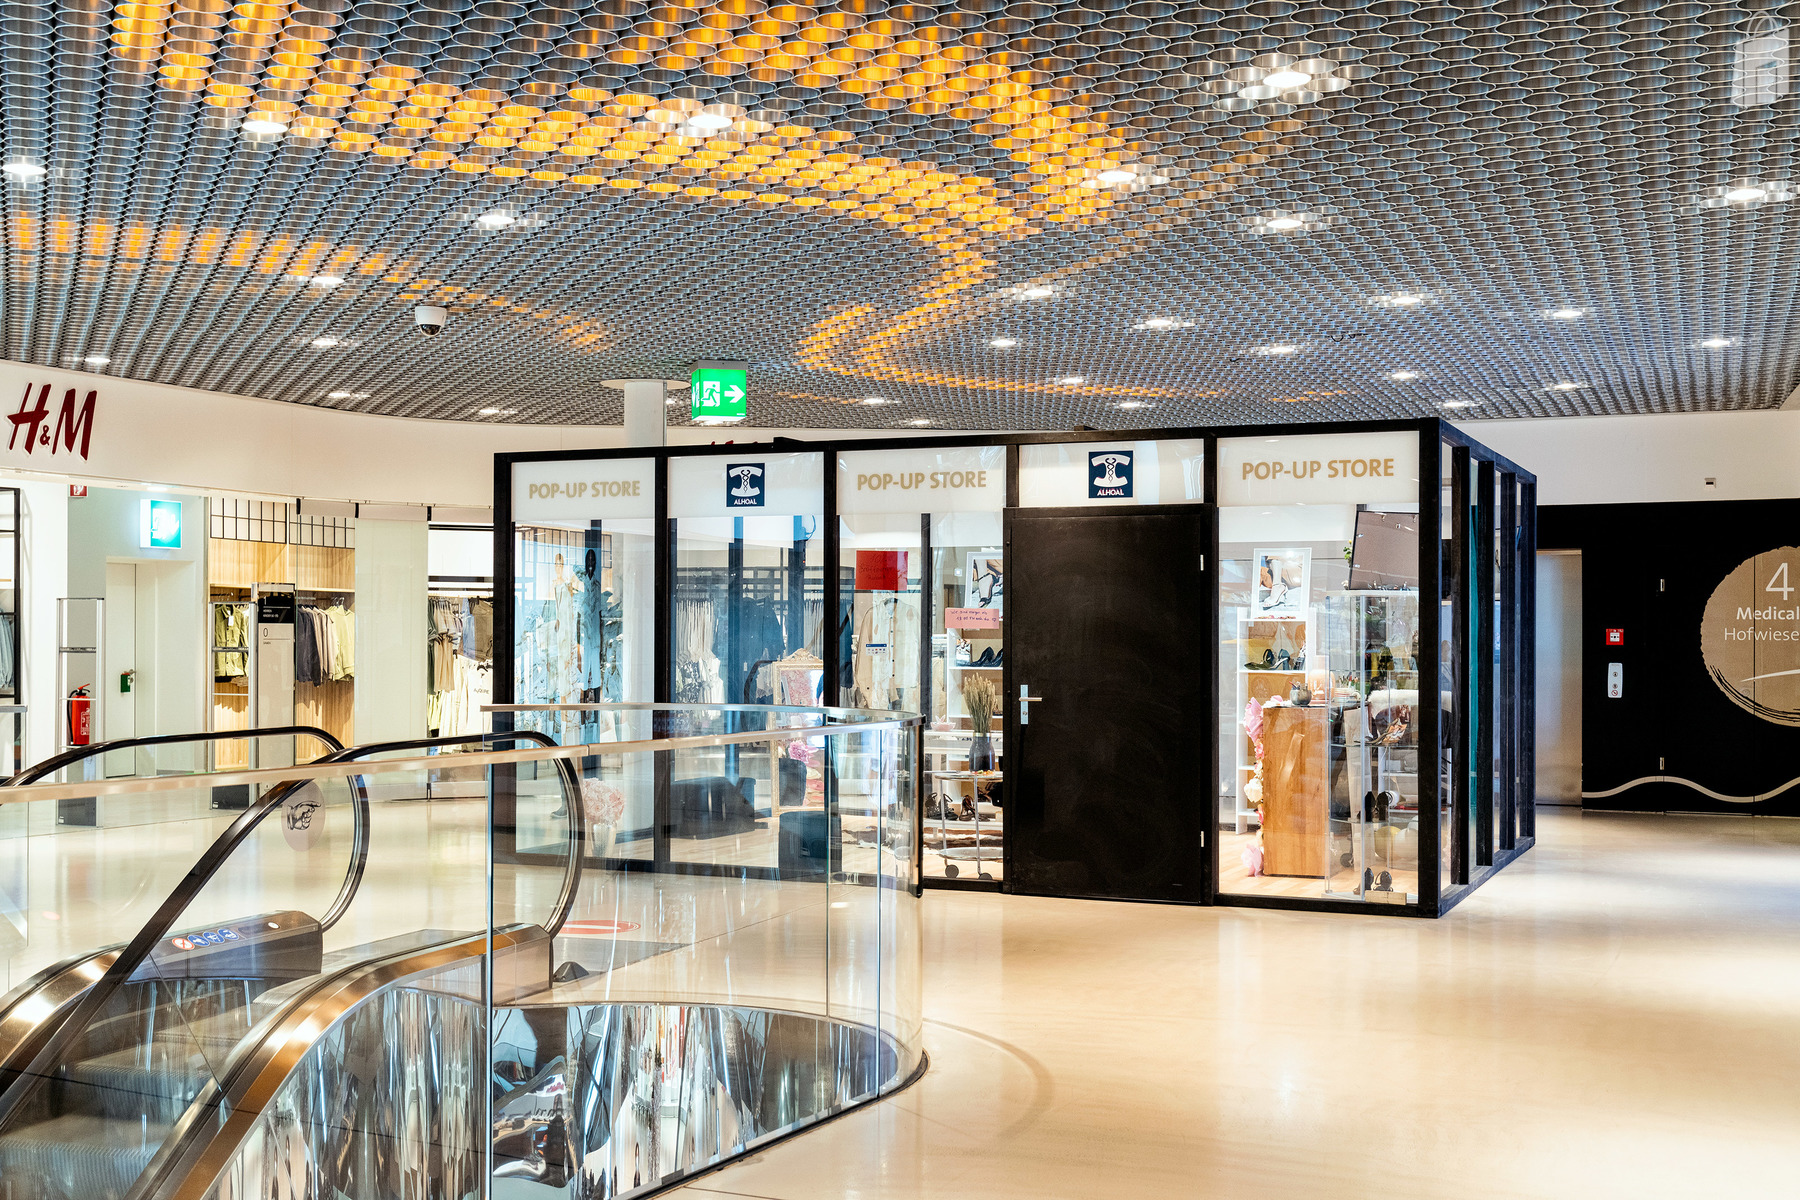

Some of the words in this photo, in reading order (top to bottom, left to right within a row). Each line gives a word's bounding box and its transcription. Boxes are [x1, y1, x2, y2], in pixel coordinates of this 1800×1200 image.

[7, 382, 98, 461] H&M
[1242, 460, 1322, 480] POP-UP
[1327, 458, 1395, 478] STORE
[529, 482, 588, 499] POP-UP
[591, 480, 641, 498] STORE
[857, 472, 925, 491] POP-UP
[929, 470, 987, 489] STORE
[1096, 488, 1124, 496] ALHOAL
[733, 498, 758, 506] ALHOAL
[1765, 562, 1795, 601] 4
[1736, 606, 1800, 620] Medical
[1724, 626, 1800, 641] Hofwiese
